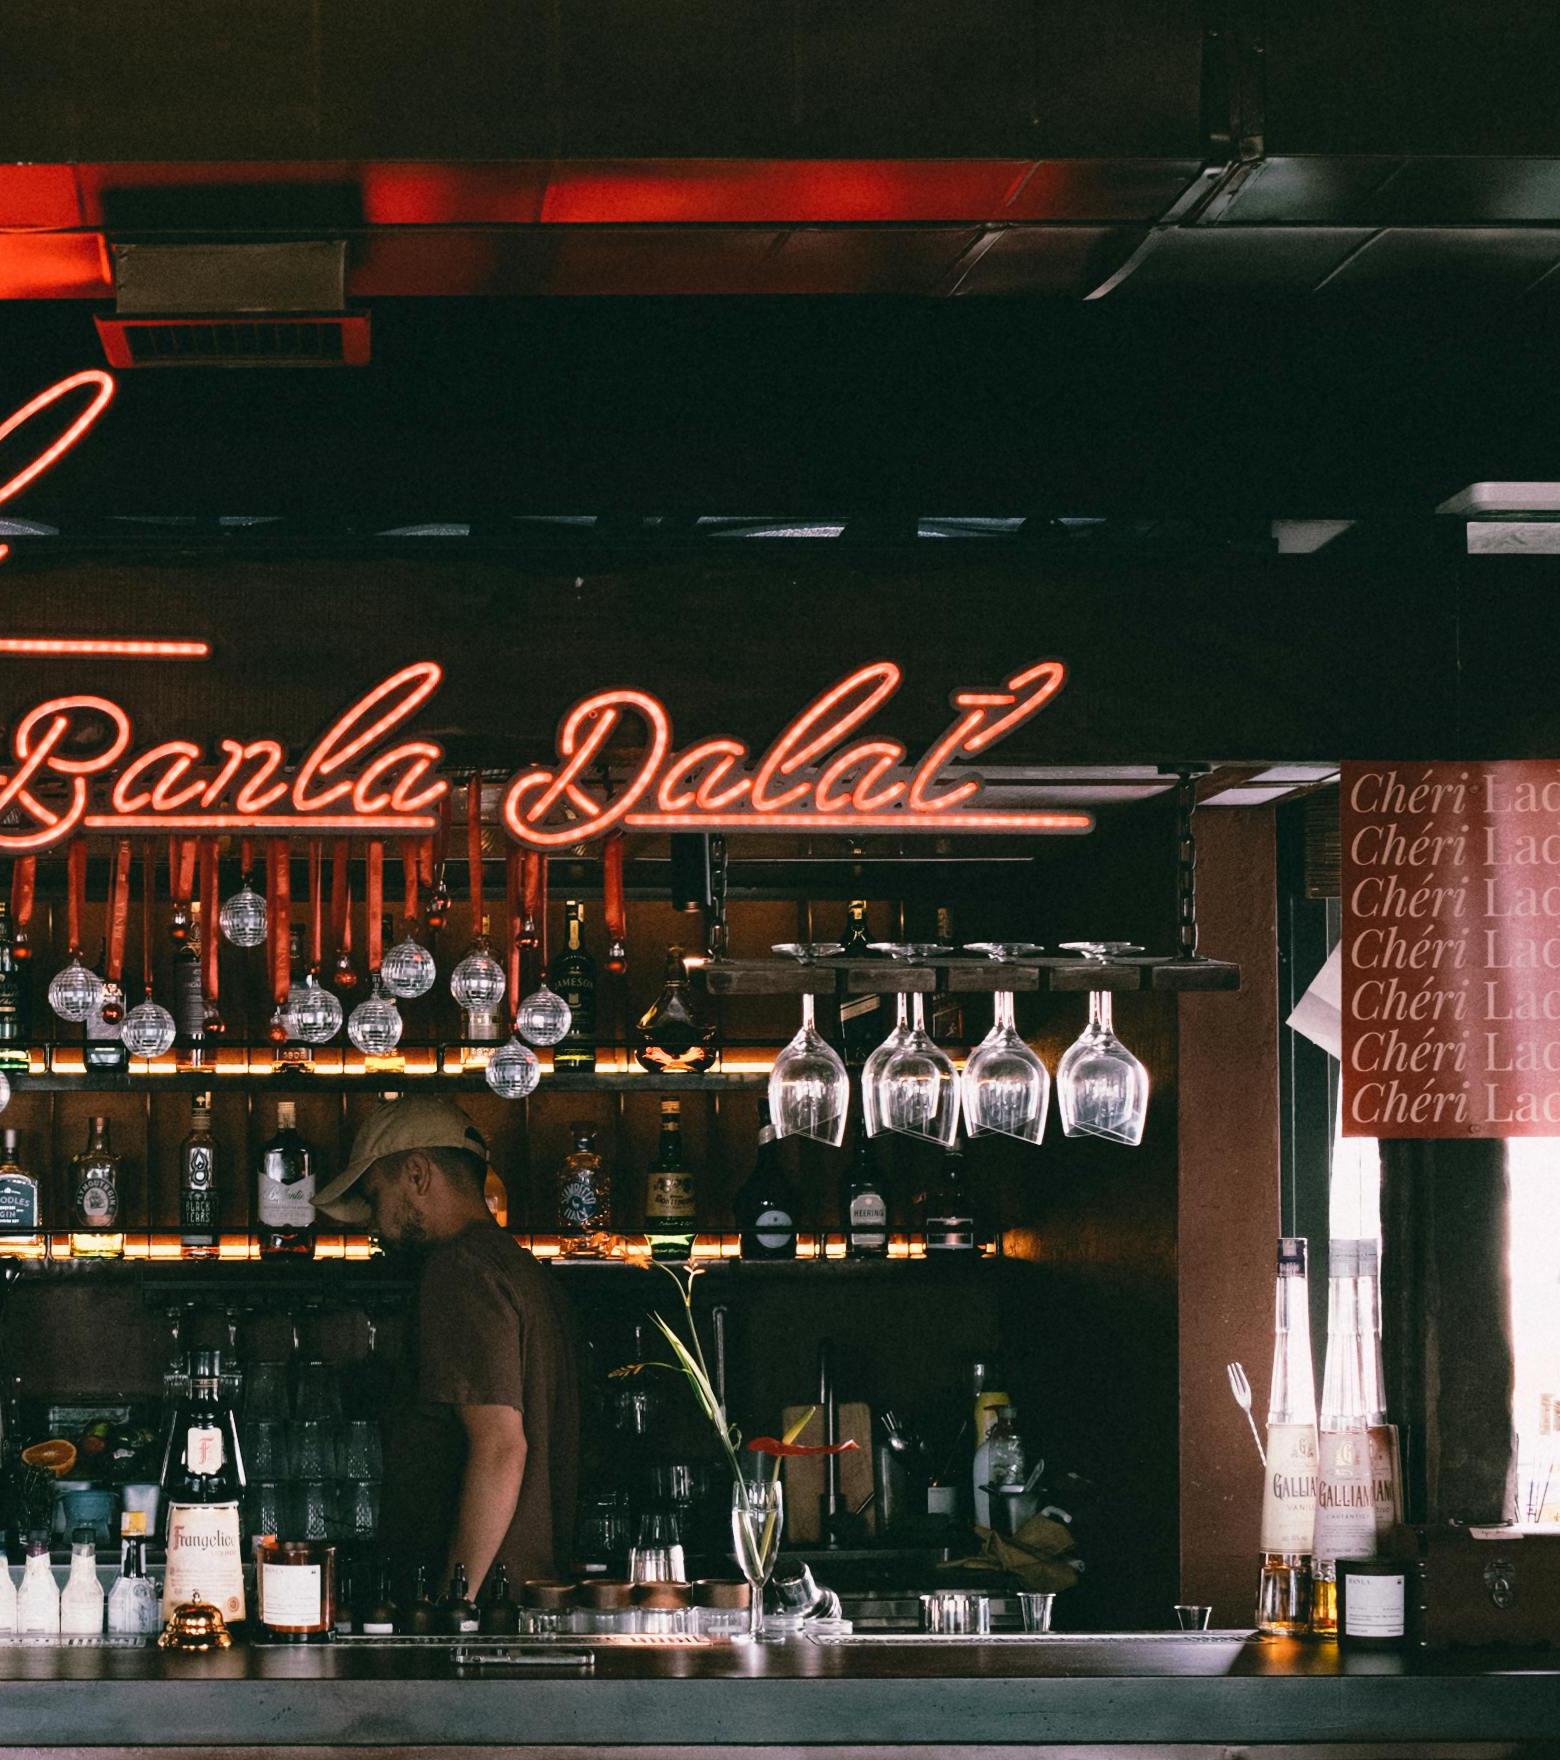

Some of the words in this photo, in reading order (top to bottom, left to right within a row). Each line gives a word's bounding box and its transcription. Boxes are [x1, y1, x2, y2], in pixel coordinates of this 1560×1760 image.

[504, 663, 1064, 848] Dalat
[1350, 772, 1466, 814] Chéri
[1350, 824, 1466, 866] Chéri
[1351, 877, 1467, 919] Chéri
[1351, 928, 1467, 970] Chéri
[1352, 980, 1468, 1022] Chéri
[1352, 1031, 1468, 1073] Chéri
[1352, 1082, 1468, 1124] Chéri
[77, 1180, 110, 1205] PLYMOUTH
[854, 1209, 884, 1217] HEERING
[1319, 1481, 1373, 1510] GALLIAN
